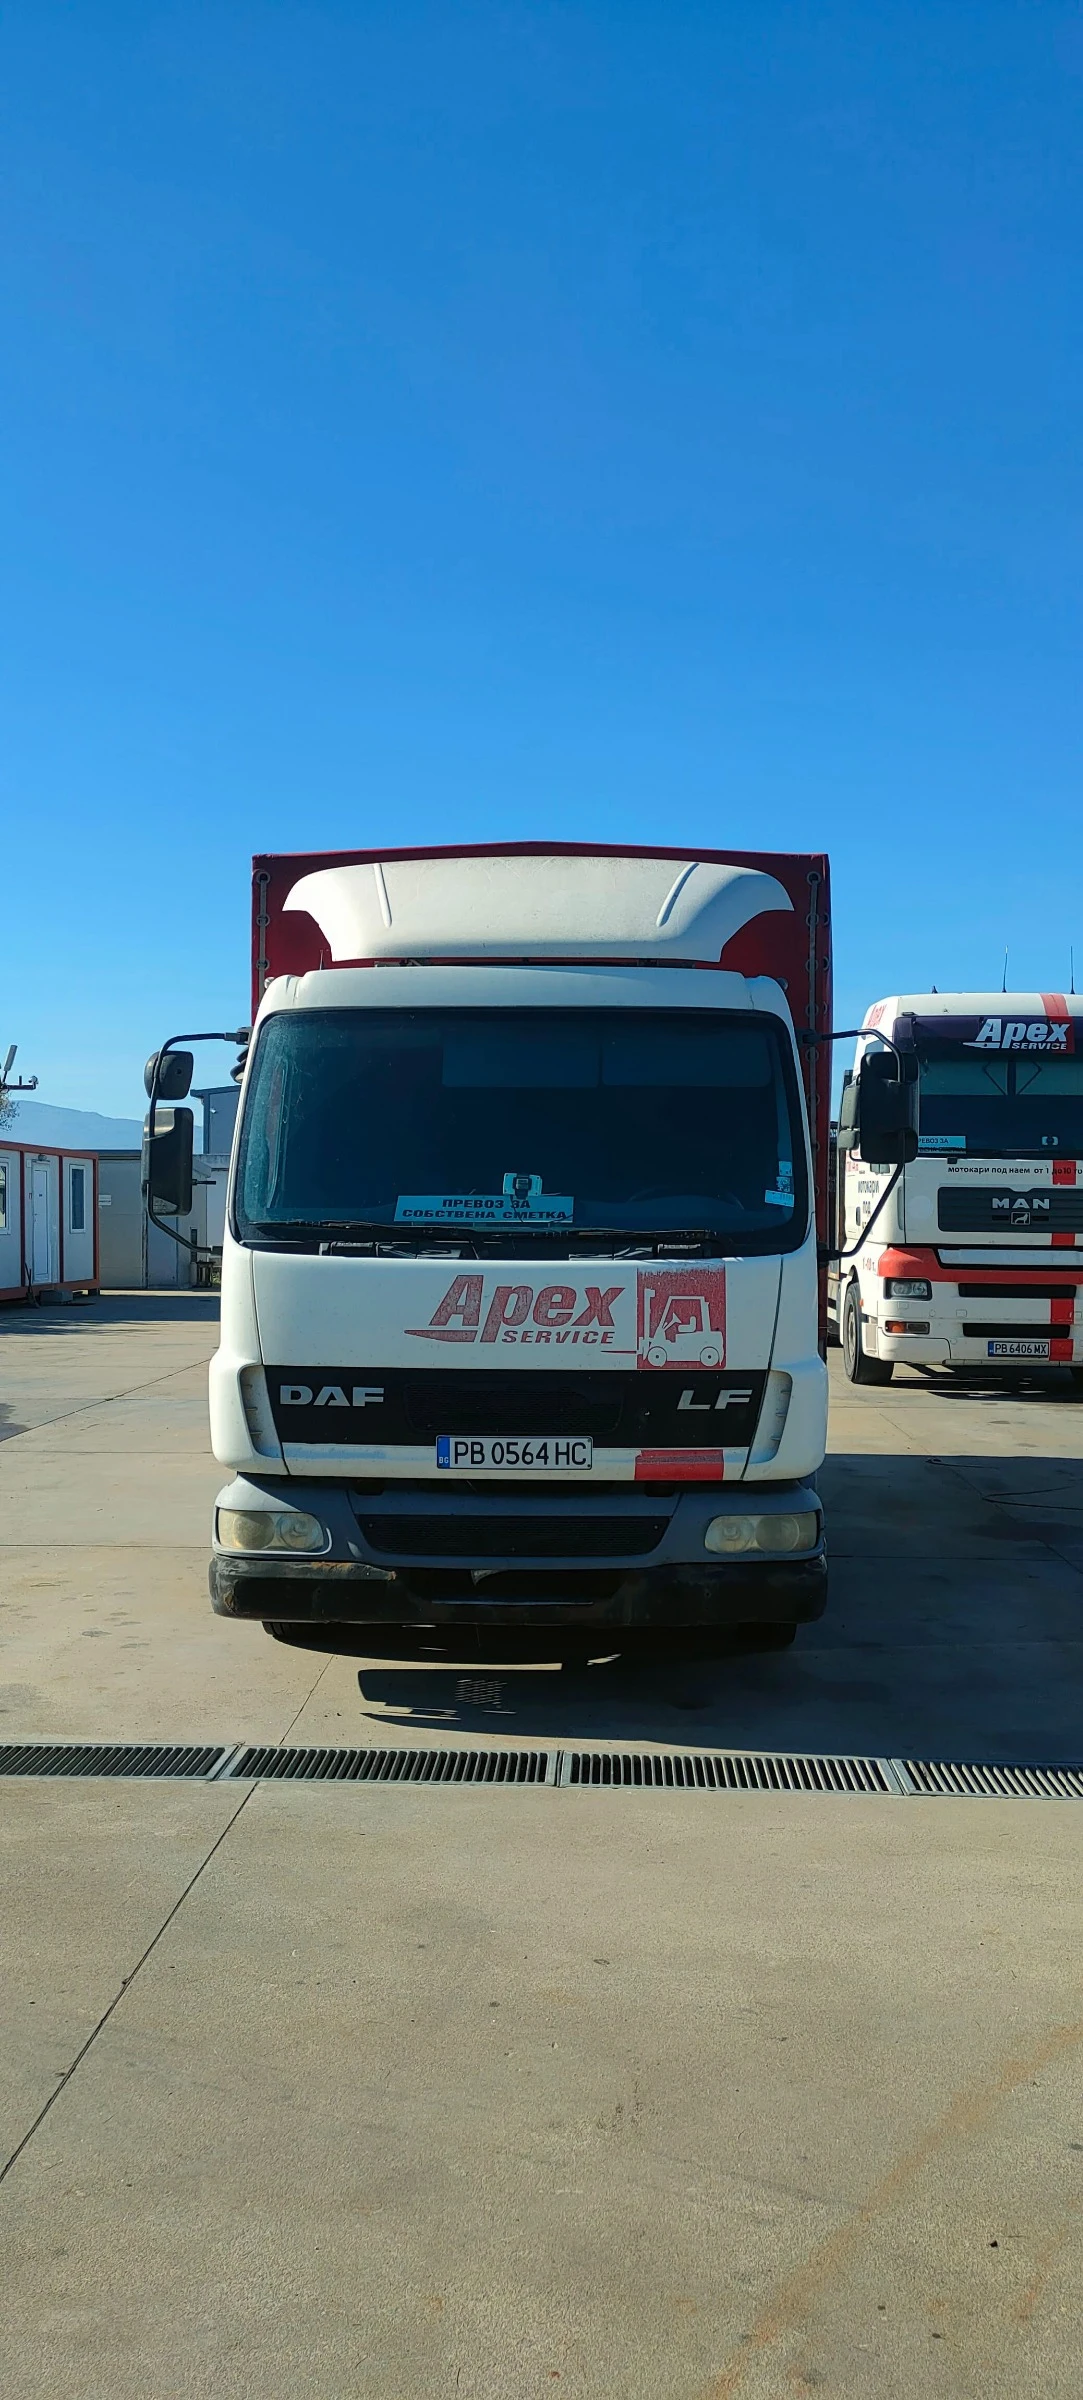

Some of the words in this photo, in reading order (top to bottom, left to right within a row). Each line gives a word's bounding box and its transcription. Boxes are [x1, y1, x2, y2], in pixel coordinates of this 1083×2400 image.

[975, 1018, 1070, 1049] Apex
[1011, 1042, 1067, 1050] SERVICE
[947, 1167, 990, 1175] мотокари
[991, 1167, 1007, 1175] под
[442, 1199, 504, 1209] ПРЕВОЗ
[510, 1199, 531, 1209] ЗА
[991, 1197, 1050, 1209] MAN
[402, 1209, 496, 1219] СОБСТВЕНА
[502, 1210, 567, 1219] СМЕТКА
[428, 1275, 626, 1343] Apex
[501, 1330, 615, 1344] SERVICE
[995, 1343, 1008, 1353] PB
[1009, 1343, 1033, 1354] 6406
[1034, 1344, 1047, 1354] MX
[279, 1385, 385, 1407] DAF
[677, 1389, 753, 1410] LF
[454, 1441, 486, 1465] PB
[491, 1441, 549, 1465] 0564
[555, 1441, 587, 1465] HC
[438, 1456, 449, 1464] BG
